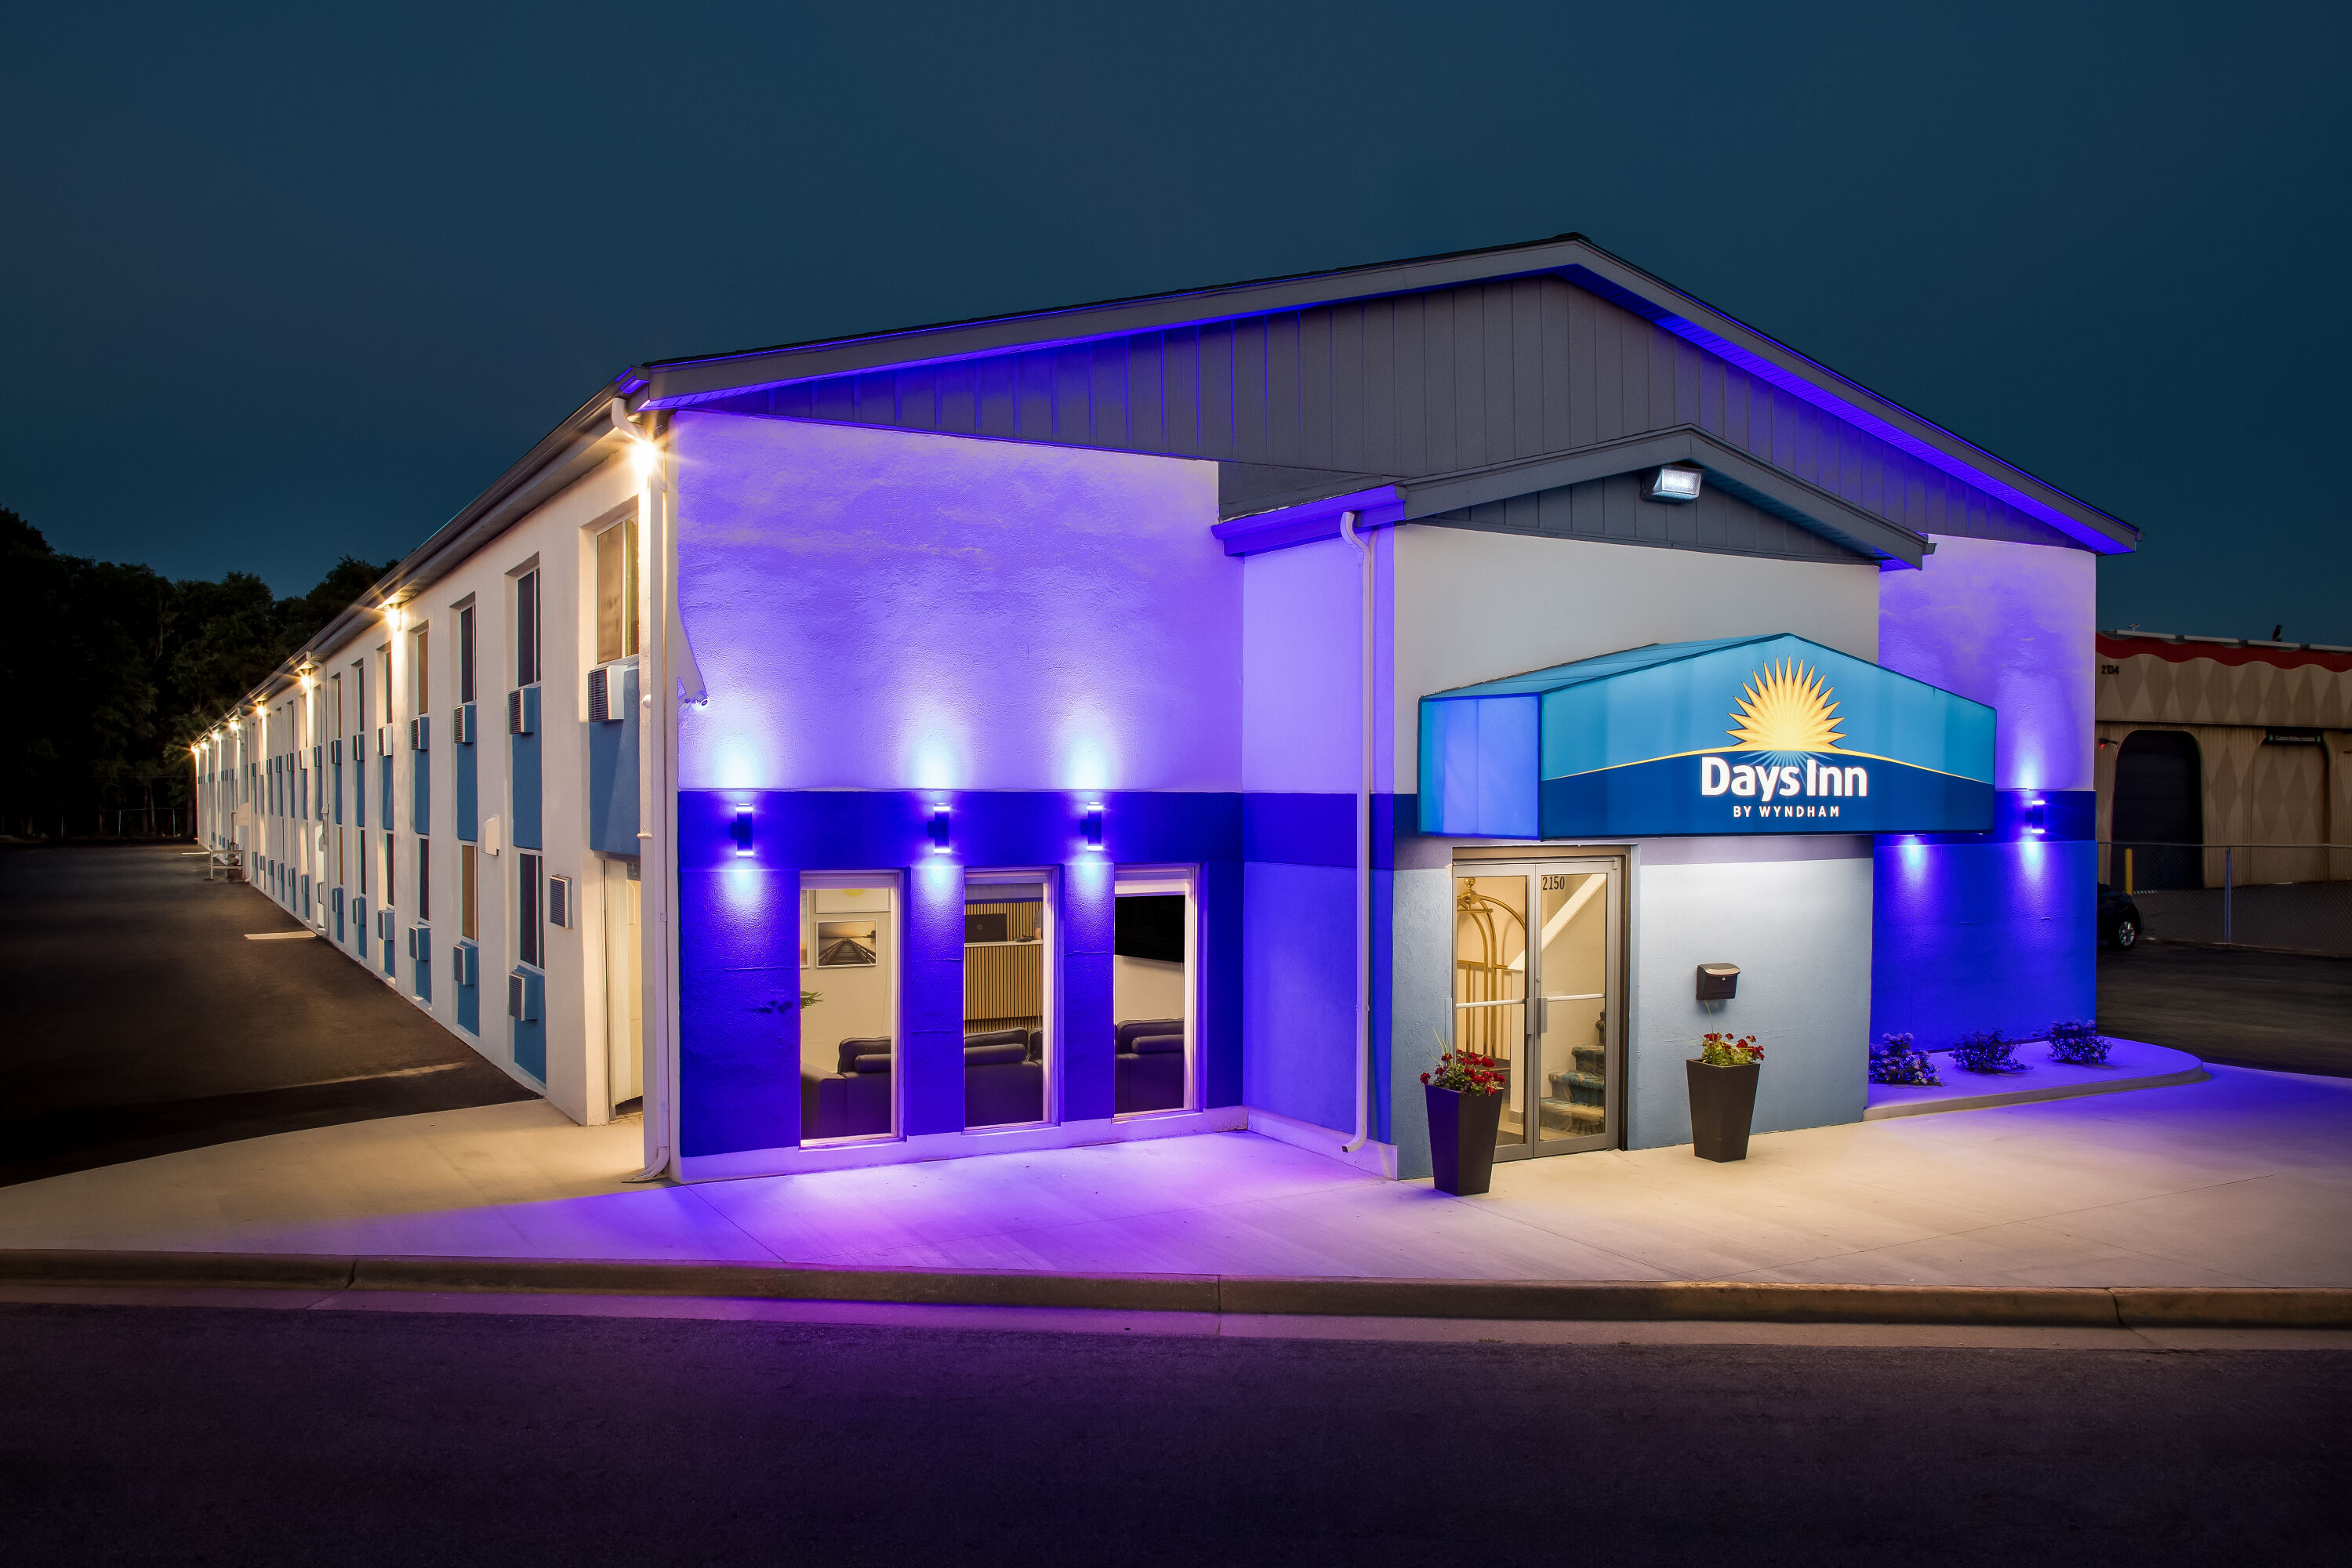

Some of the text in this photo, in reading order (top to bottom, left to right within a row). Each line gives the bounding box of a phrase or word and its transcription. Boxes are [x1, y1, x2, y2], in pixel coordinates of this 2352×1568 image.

[1700, 757, 1868, 802] Days Inn
[1733, 805, 1841, 818] BY WYNDHAM
[1542, 876, 1566, 891] 2150
